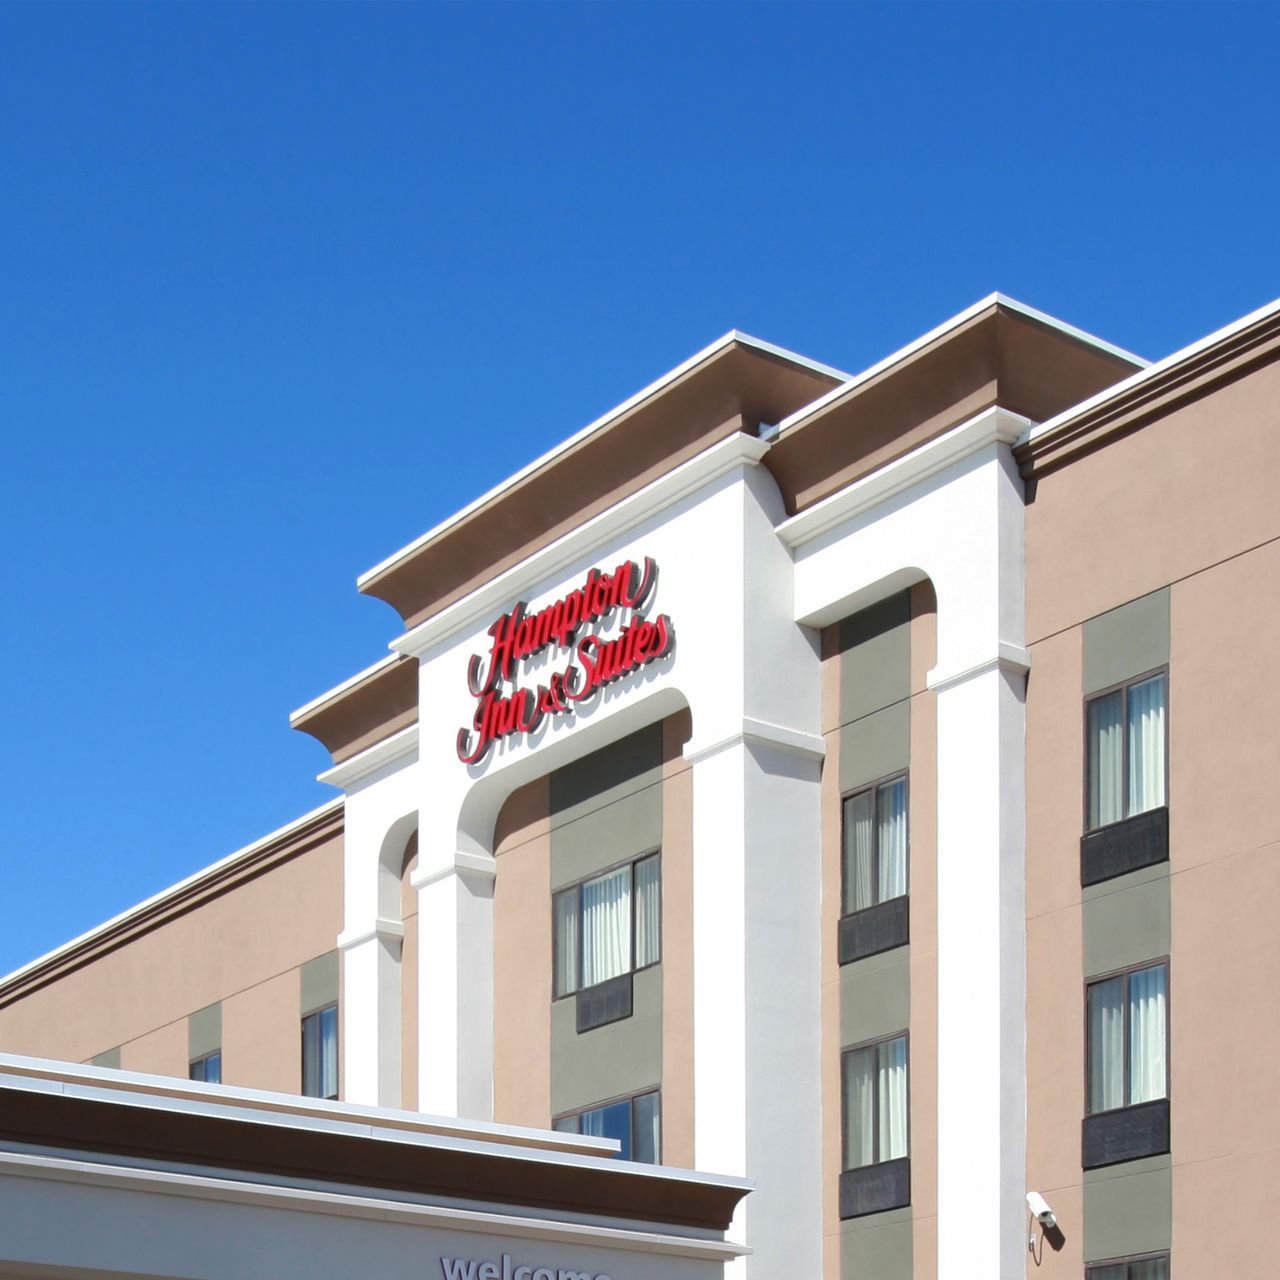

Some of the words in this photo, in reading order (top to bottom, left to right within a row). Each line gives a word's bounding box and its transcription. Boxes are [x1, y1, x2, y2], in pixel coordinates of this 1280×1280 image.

[457, 685, 549, 764] Inn
[540, 672, 573, 714] &
[562, 613, 672, 702] Suites
[468, 556, 656, 698] Hampton
